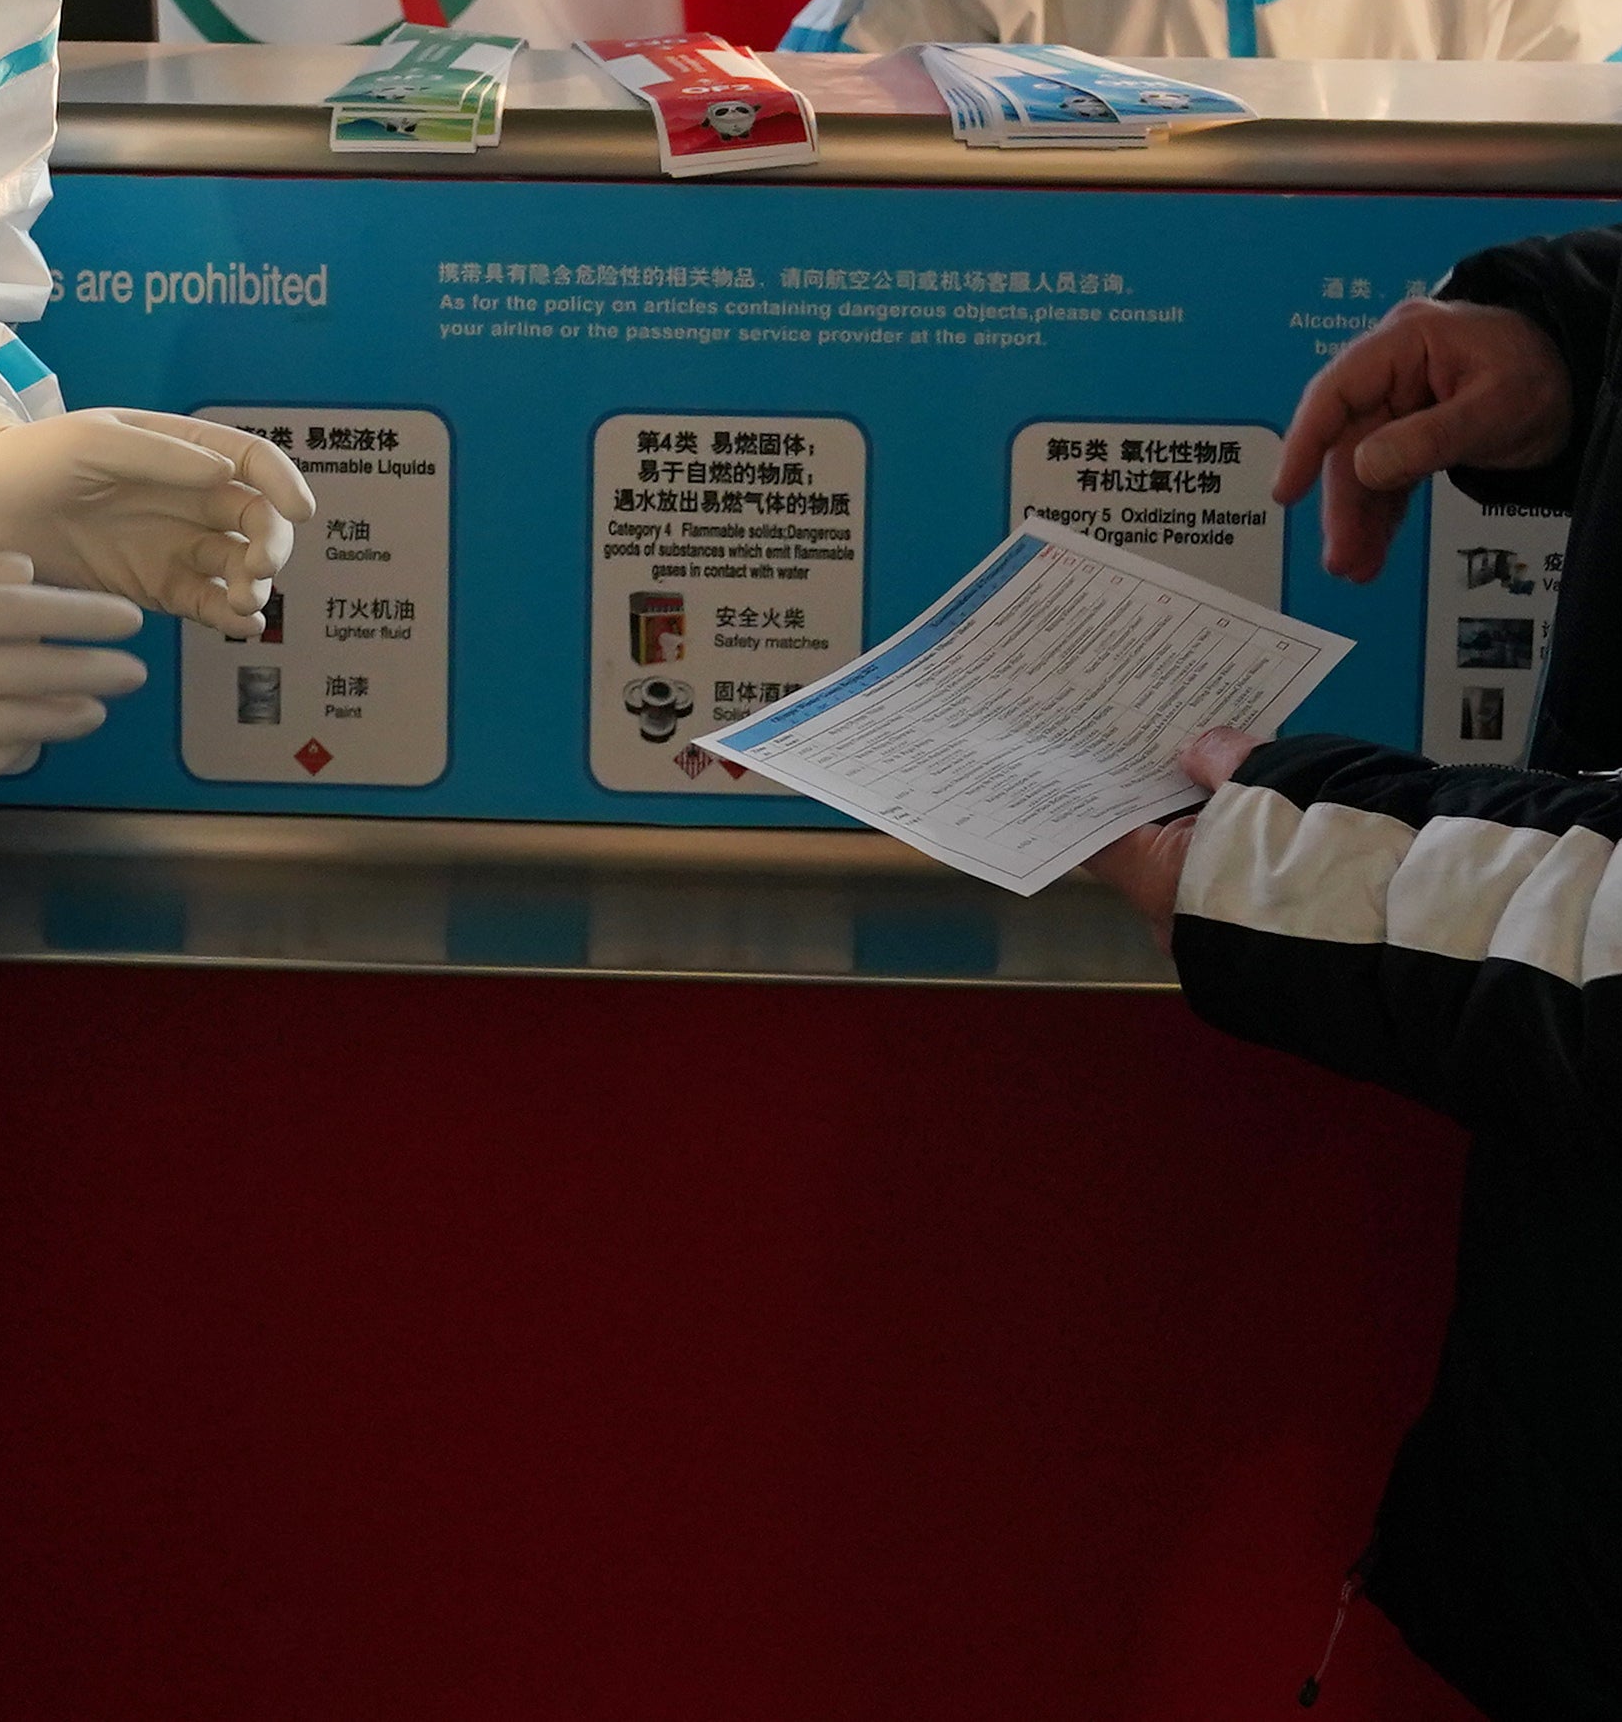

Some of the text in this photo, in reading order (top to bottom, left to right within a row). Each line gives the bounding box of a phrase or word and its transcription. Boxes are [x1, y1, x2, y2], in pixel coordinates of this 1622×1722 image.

[77, 269, 134, 303] are
[145, 261, 328, 314] prohibited
[439, 294, 465, 310] As
[472, 294, 499, 310] for
[506, 295, 537, 311] the
[545, 296, 604, 316] policy
[612, 300, 637, 313] on
[644, 298, 718, 314] articles
[724, 300, 831, 321] containing
[838, 302, 946, 321] dangerous
[1109, 307, 1185, 323] consult
[440, 322, 484, 339] your
[491, 321, 553, 338] airline
[560, 326, 580, 338] or
[587, 323, 618, 339] the
[627, 326, 730, 344] passenger
[738, 328, 811, 342] service
[818, 329, 902, 346] provider
[910, 330, 929, 345] at
[936, 329, 966, 345] the
[305, 427, 399, 452] 易燃液体
[637, 430, 698, 455] 第4类
[1046, 438, 1108, 462] 第5类
[291, 458, 436, 478] lammable Liquids
[1023, 505, 1266, 527] Category 5 Oxidizing Material
[326, 519, 370, 541] 汽油
[608, 520, 663, 540] Category
[664, 523, 672, 537] 4
[681, 522, 745, 539] Flammable
[1094, 526, 1158, 547] Organic
[1163, 529, 1234, 546] Peroxide
[325, 546, 391, 562] Gasoline
[604, 542, 855, 562] goods of substances which emit flammable
[652, 562, 810, 580] gases in contact with water
[326, 597, 415, 620] 打火机油
[716, 606, 805, 628] 安全火柴
[325, 625, 412, 641] Lighter fluid
[714, 633, 829, 652] Safety matches
[325, 675, 369, 697] 油漆
[324, 704, 363, 719] Paint
